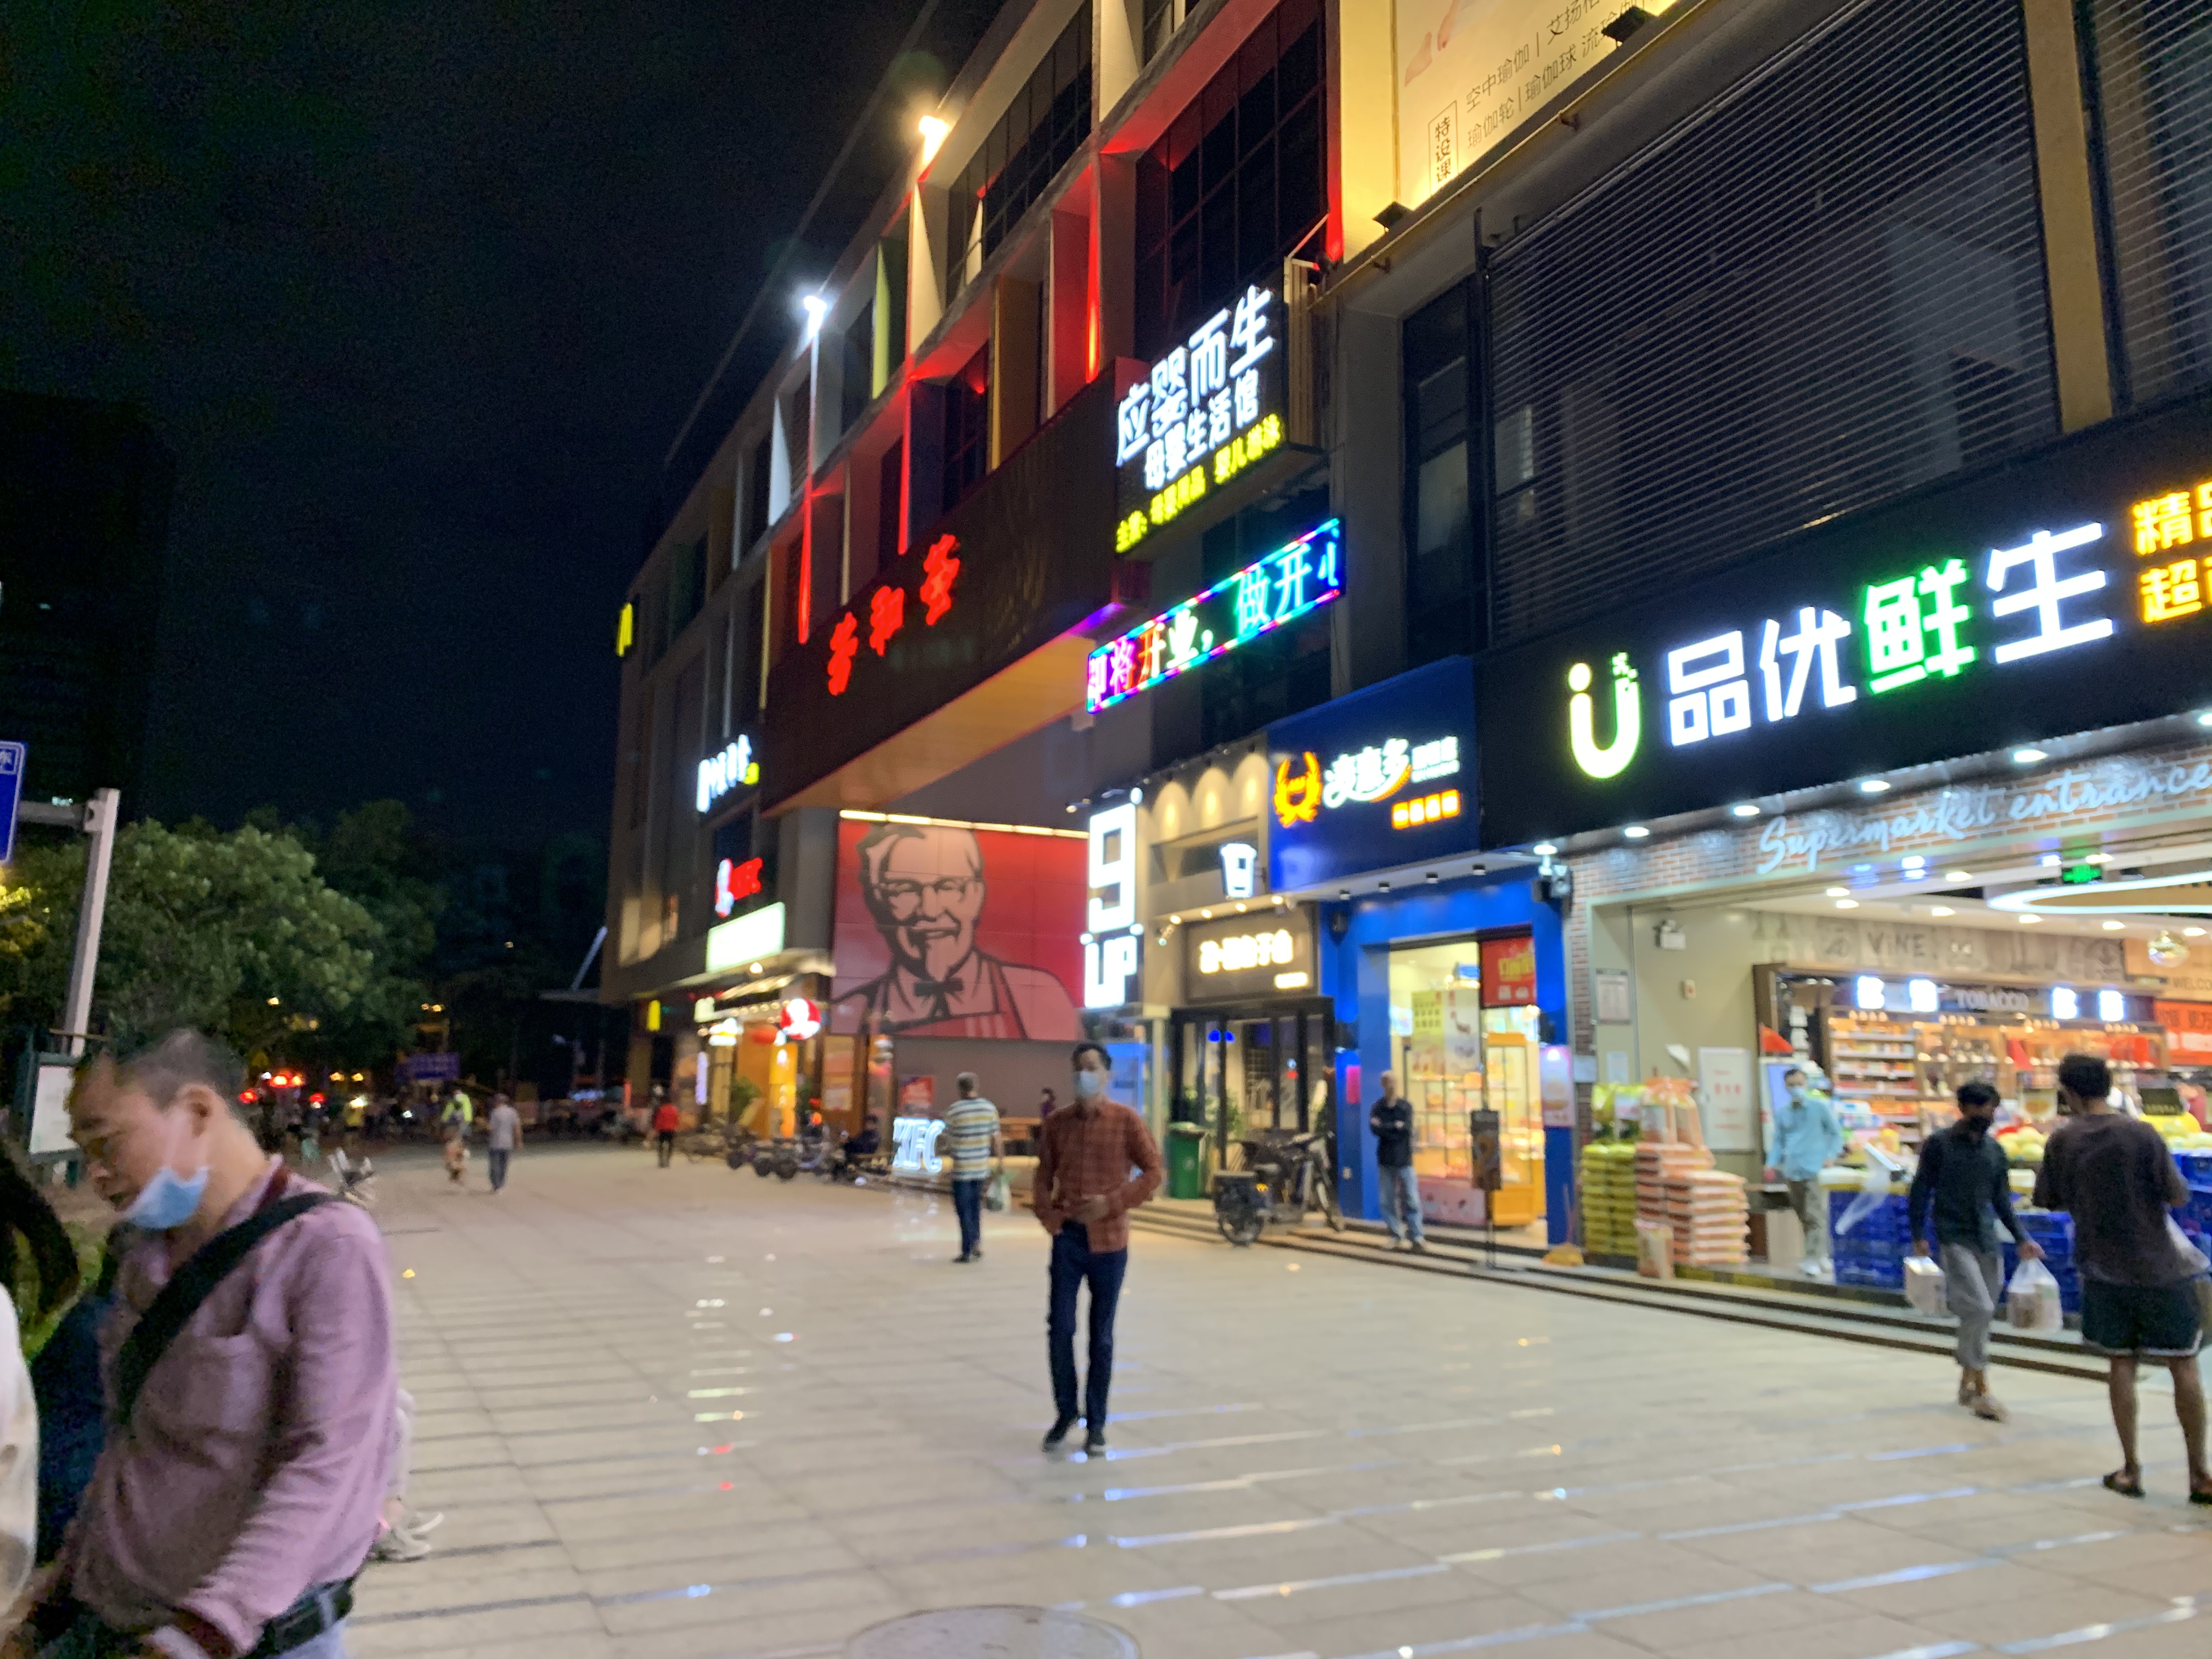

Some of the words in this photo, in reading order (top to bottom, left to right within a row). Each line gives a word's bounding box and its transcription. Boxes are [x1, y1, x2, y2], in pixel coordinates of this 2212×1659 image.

[1466, 43, 1530, 113] 空中瑜伽
[1467, 97, 1514, 149] 瑜伽轮
[1525, 44, 1577, 103] 瑜伽球
[1435, 116, 1452, 183] 特设课
[2140, 555, 2212, 623] 超
[1667, 521, 2115, 747] 品优鲜生
[1757, 788, 2007, 874] Supermarket
[2009, 763, 2212, 820] entrance
